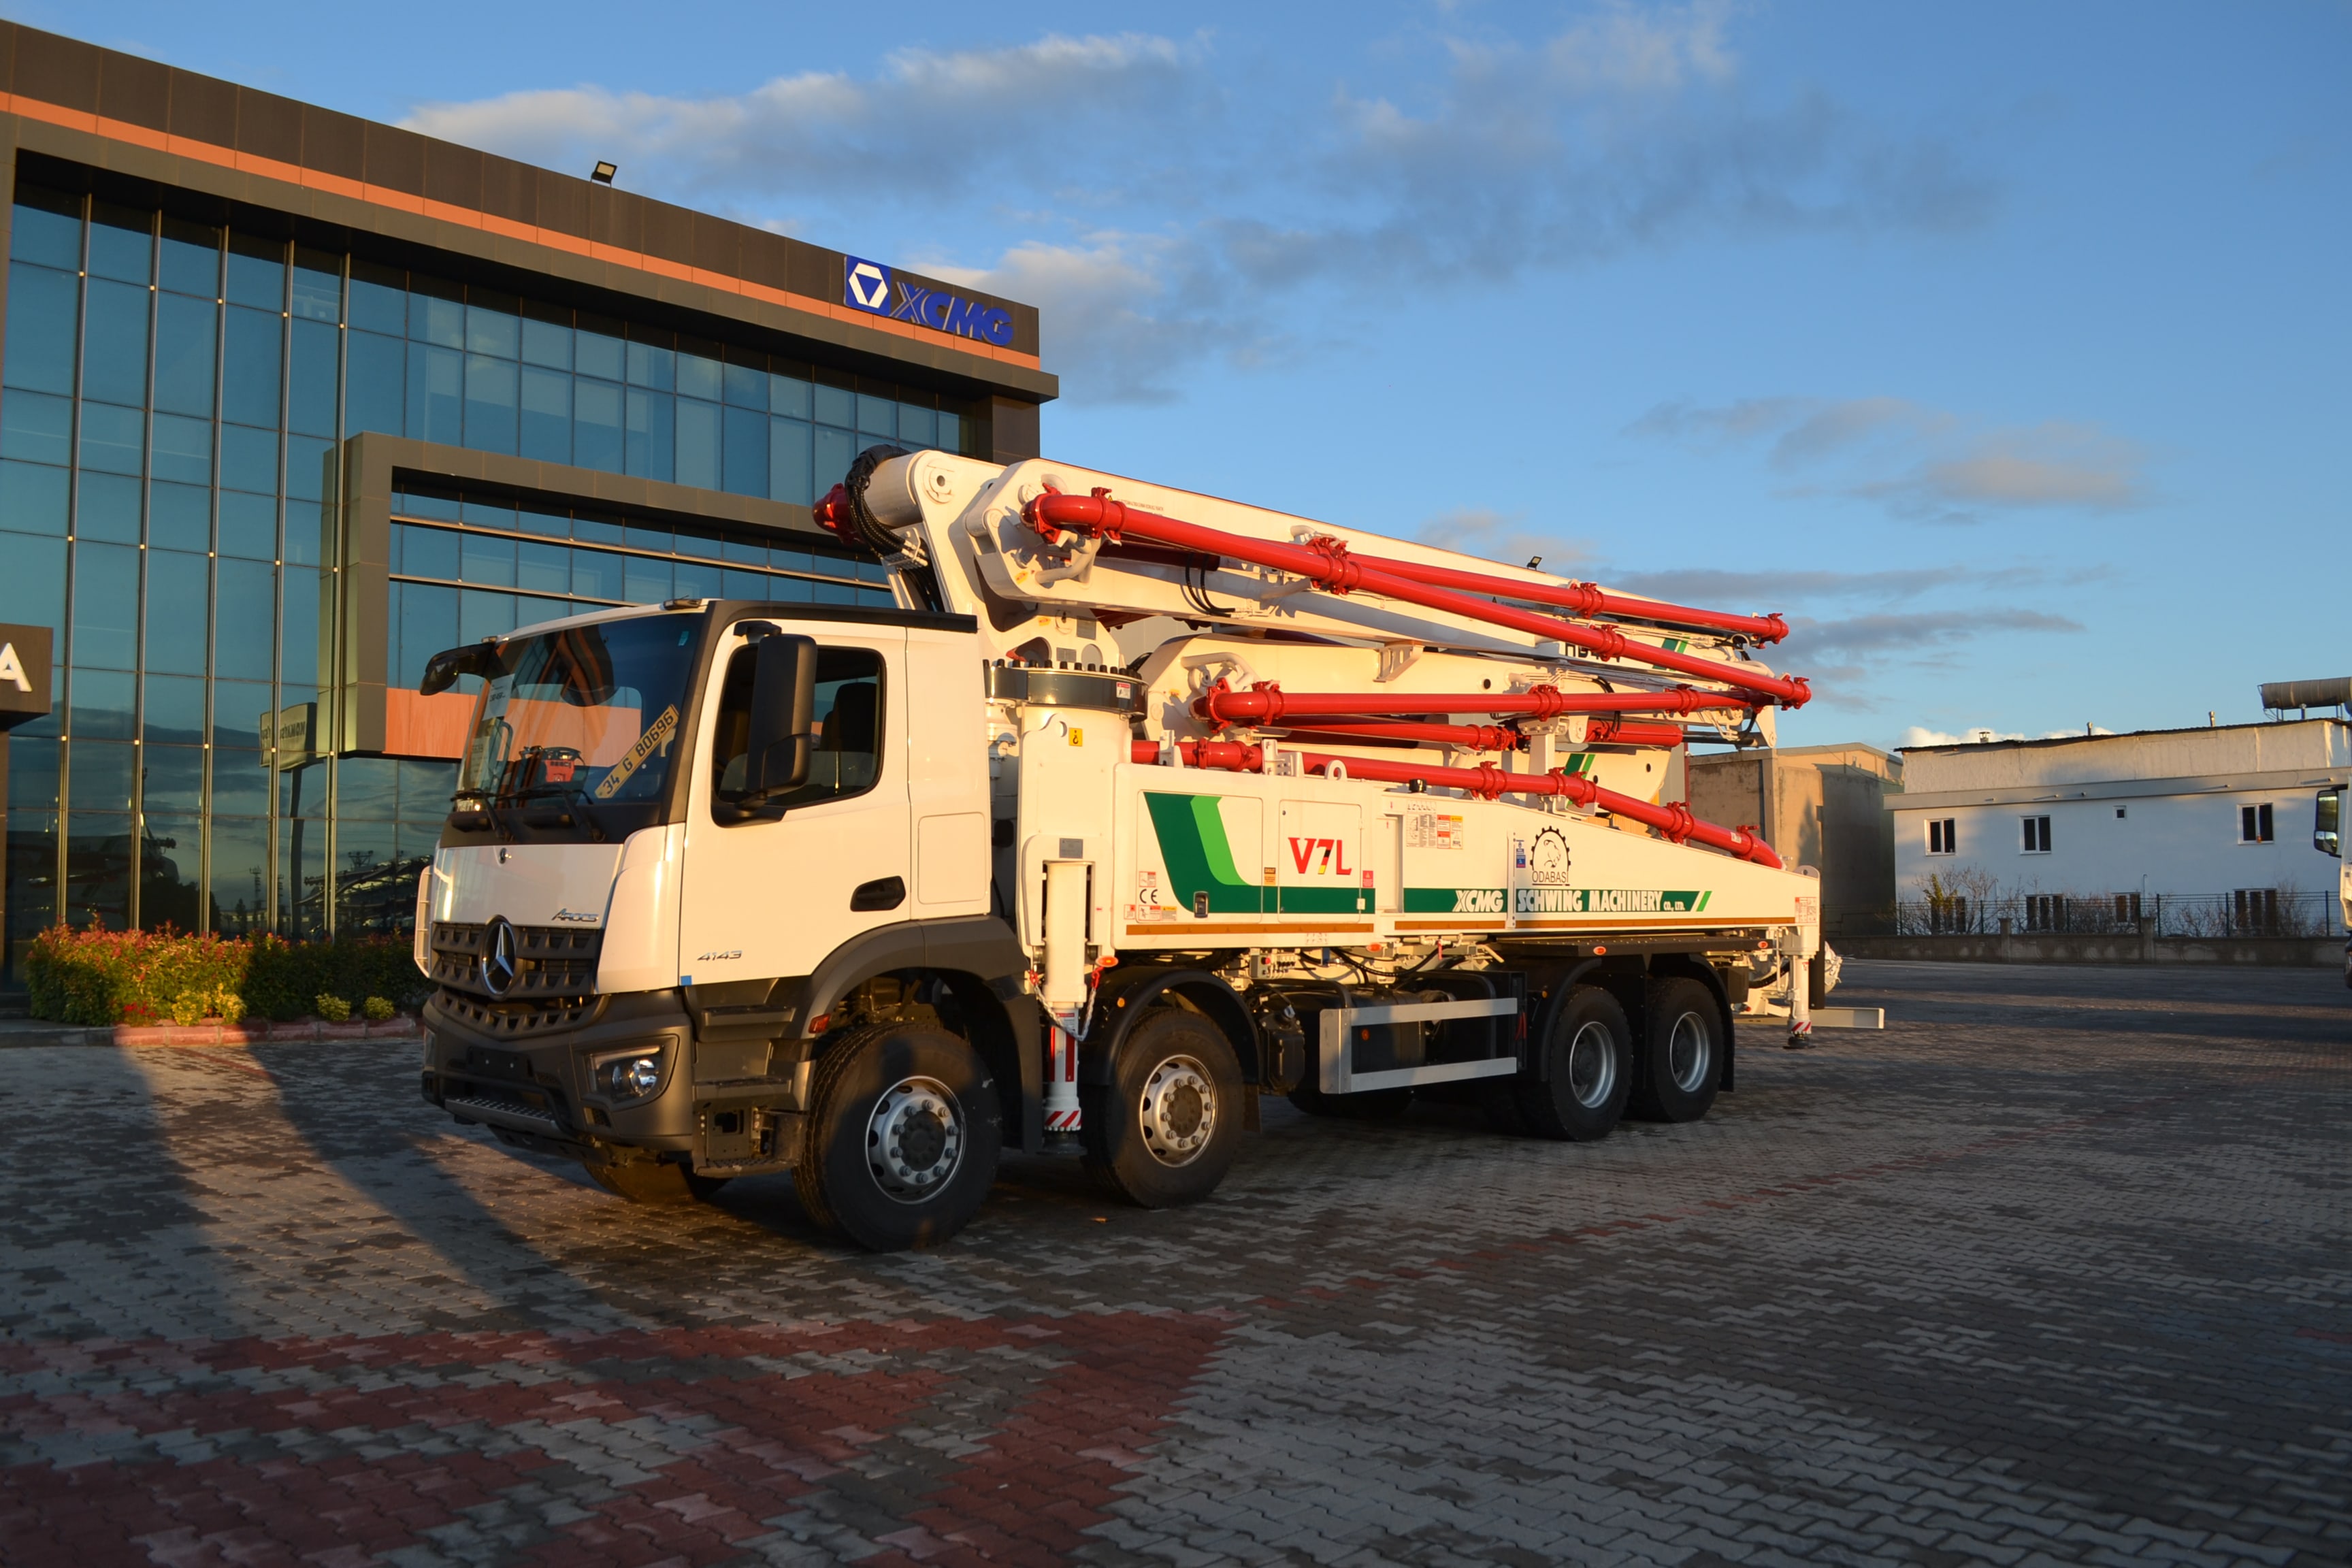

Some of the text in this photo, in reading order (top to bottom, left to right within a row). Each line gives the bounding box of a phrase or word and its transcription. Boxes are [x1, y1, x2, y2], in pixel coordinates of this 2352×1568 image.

[889, 281, 1014, 346] XCMG
[0, 642, 33, 692] A
[603, 711, 674, 795] 34 G 80696
[1288, 837, 1352, 875] V7L
[1139, 888, 1158, 904] CE
[1452, 889, 1503, 912] XCMG
[1518, 889, 1582, 912] SCHWING
[1588, 890, 1663, 911] MACHINERY
[697, 950, 742, 961] 4143
